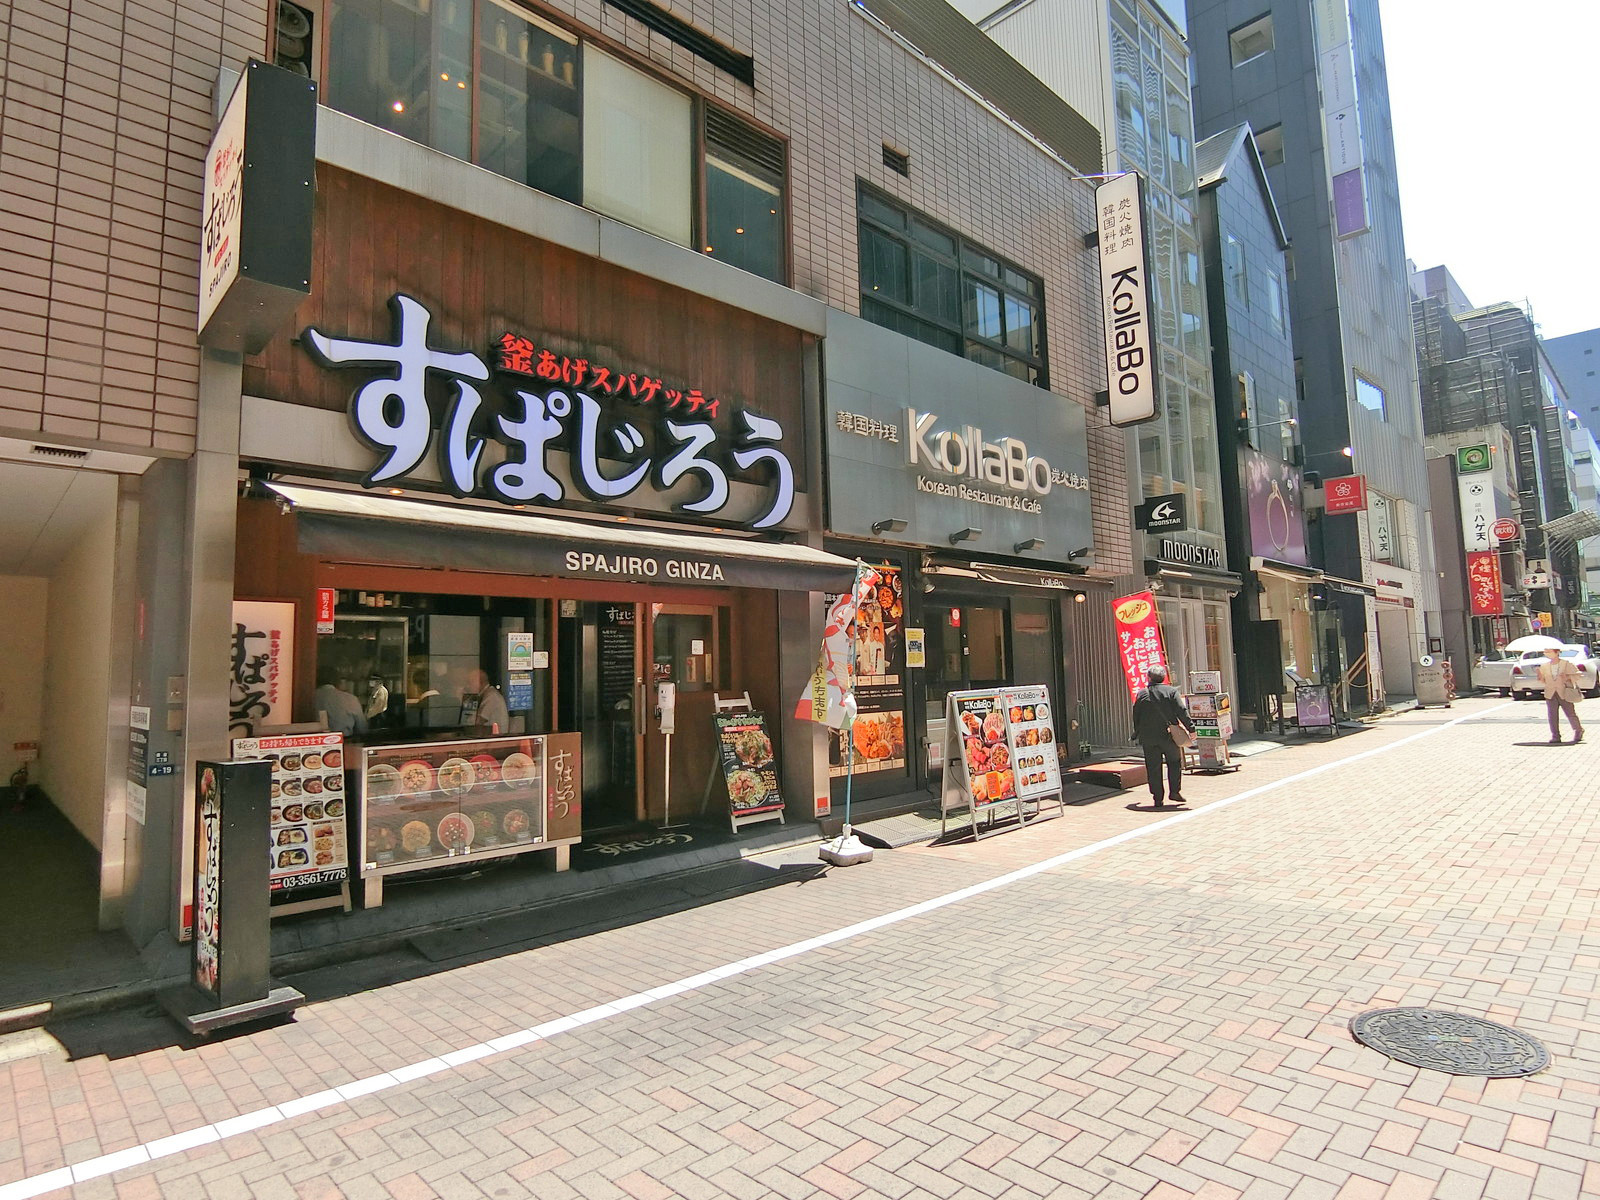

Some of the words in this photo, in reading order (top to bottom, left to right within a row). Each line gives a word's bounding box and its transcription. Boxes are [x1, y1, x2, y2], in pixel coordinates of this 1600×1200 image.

[1102, 204, 1118, 255] 韓国料理
[1118, 198, 1134, 250] 炭火焼肉
[1111, 265, 1145, 395] KollaBo
[500, 332, 722, 419] 釜あげスパゲッティ
[308, 293, 795, 529] すぱじろう
[836, 410, 899, 443] 韓国料理
[906, 406, 1052, 496] KollaBo
[917, 475, 958, 498] Korean
[959, 484, 1012, 511] Restaurant
[1013, 496, 1021, 510] &
[1021, 497, 1042, 515] Cafe
[1050, 468, 1088, 491] 炭火焼肉
[1474, 514, 1486, 541] ハゲ天
[565, 551, 659, 577] SPAJIRO
[665, 560, 725, 581] GINZA
[1118, 602, 1149, 622] フレッシュ
[1143, 626, 1161, 664] お弁当
[260, 736, 324, 749] お持ち帰りできます
[151, 766, 172, 775] 4-19
[283, 868, 347, 889] 03-3561-7778
